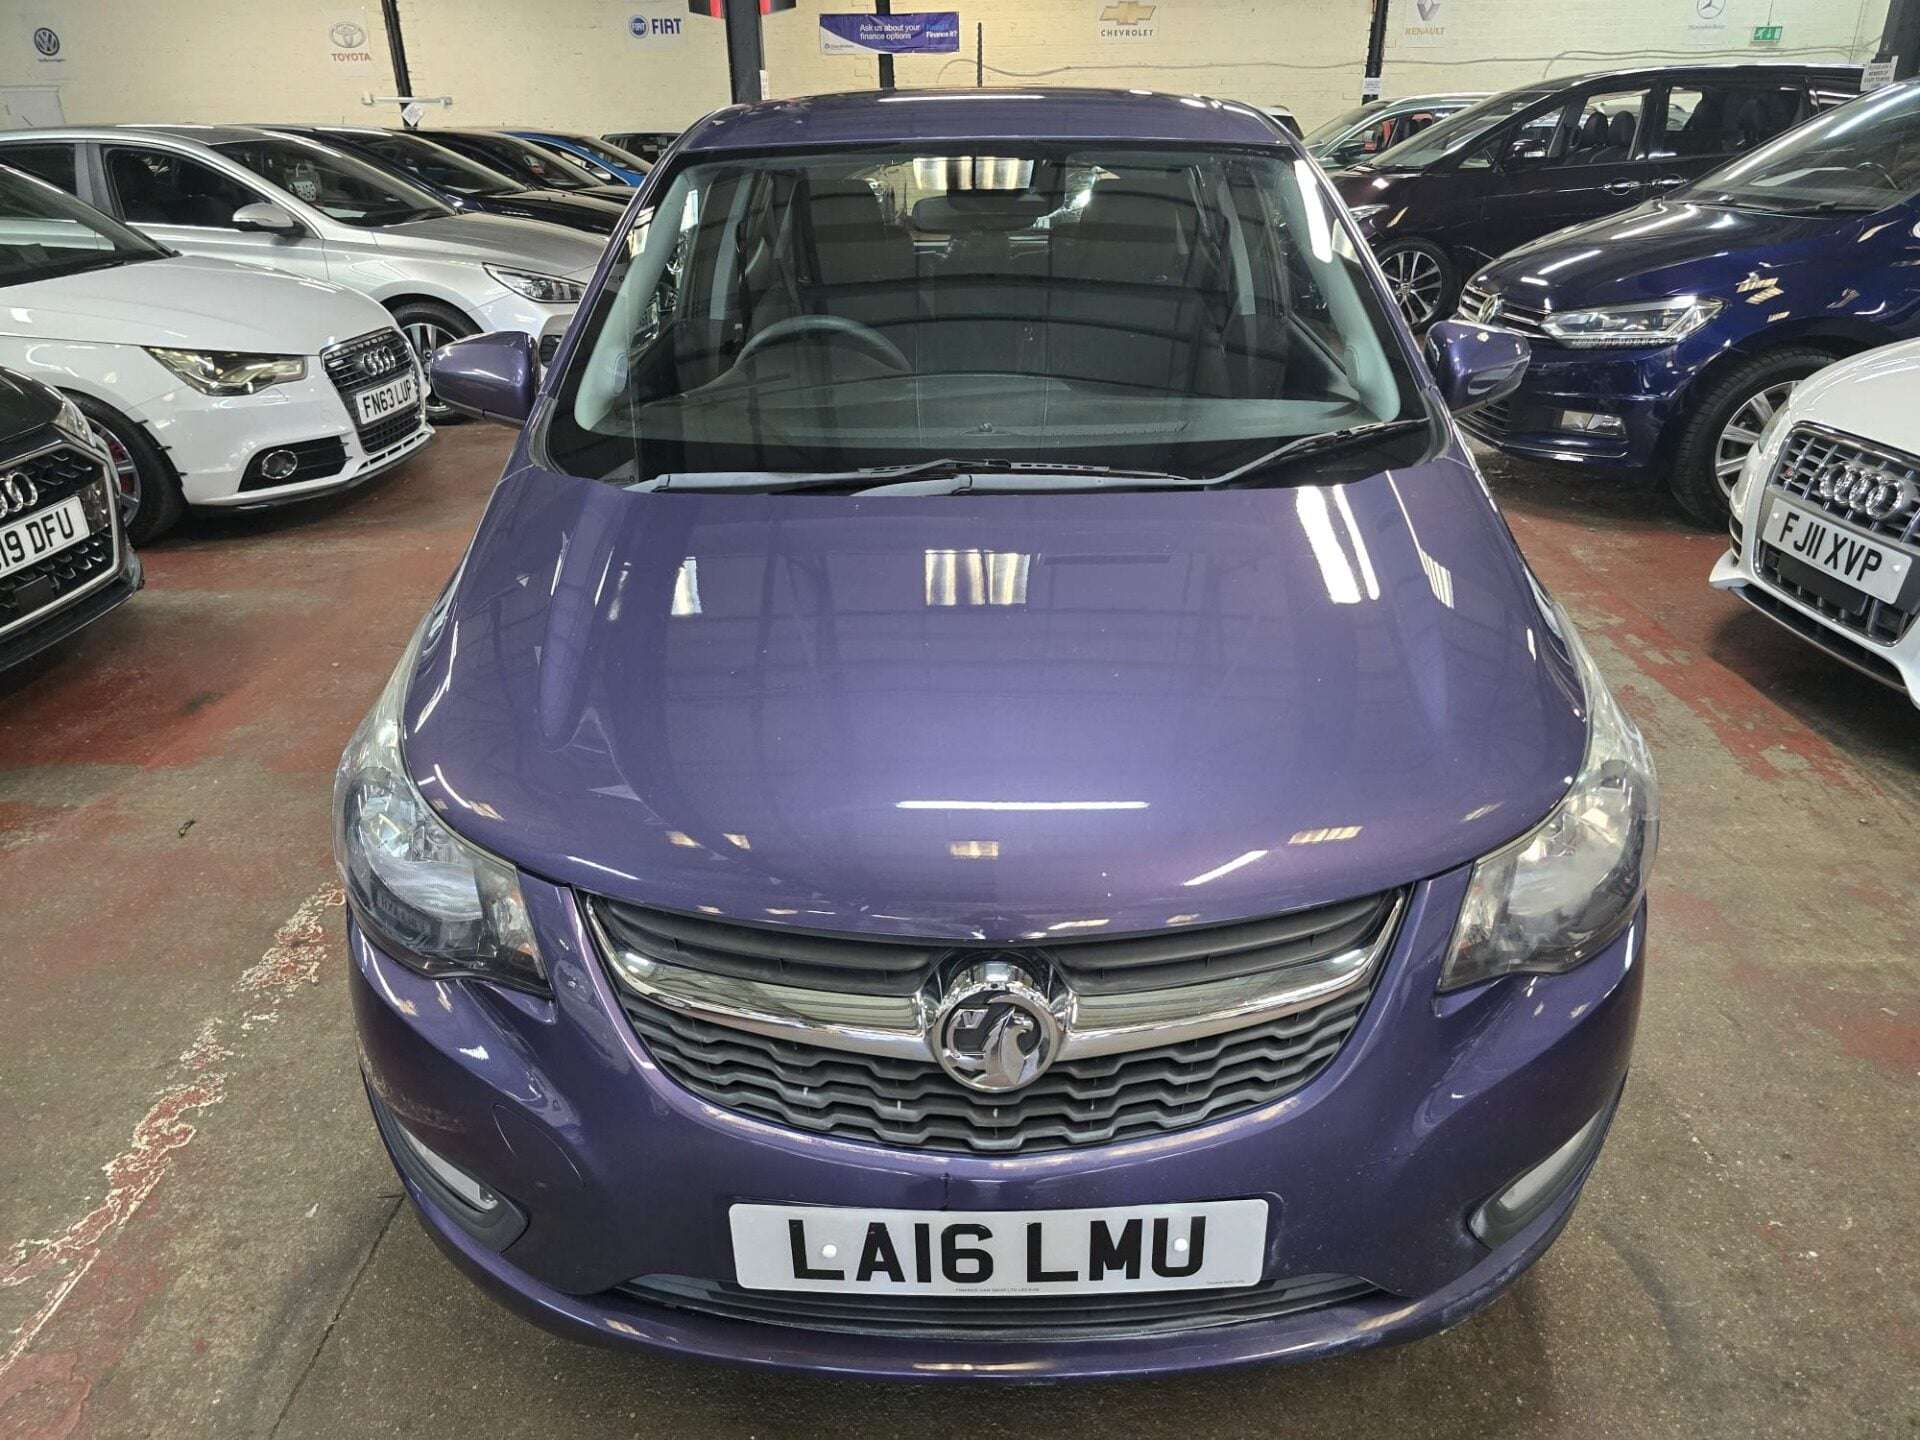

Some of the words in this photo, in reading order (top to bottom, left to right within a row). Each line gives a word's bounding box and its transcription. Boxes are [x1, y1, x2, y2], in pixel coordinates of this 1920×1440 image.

[651, 18, 681, 35] FIAT
[904, 25, 920, 33] your
[1100, 29, 1153, 37] CHEVROLET
[860, 32, 884, 40] finance
[886, 32, 912, 40] options
[331, 52, 371, 62] TOYOTA
[362, 388, 396, 418] FN63
[394, 379, 412, 405] LUP
[0, 530, 25, 571] 19
[25, 507, 74, 554] DFU
[1824, 532, 1882, 582] XVP
[788, 1218, 994, 1284] LA16
[1026, 1215, 1206, 1283] LMU
